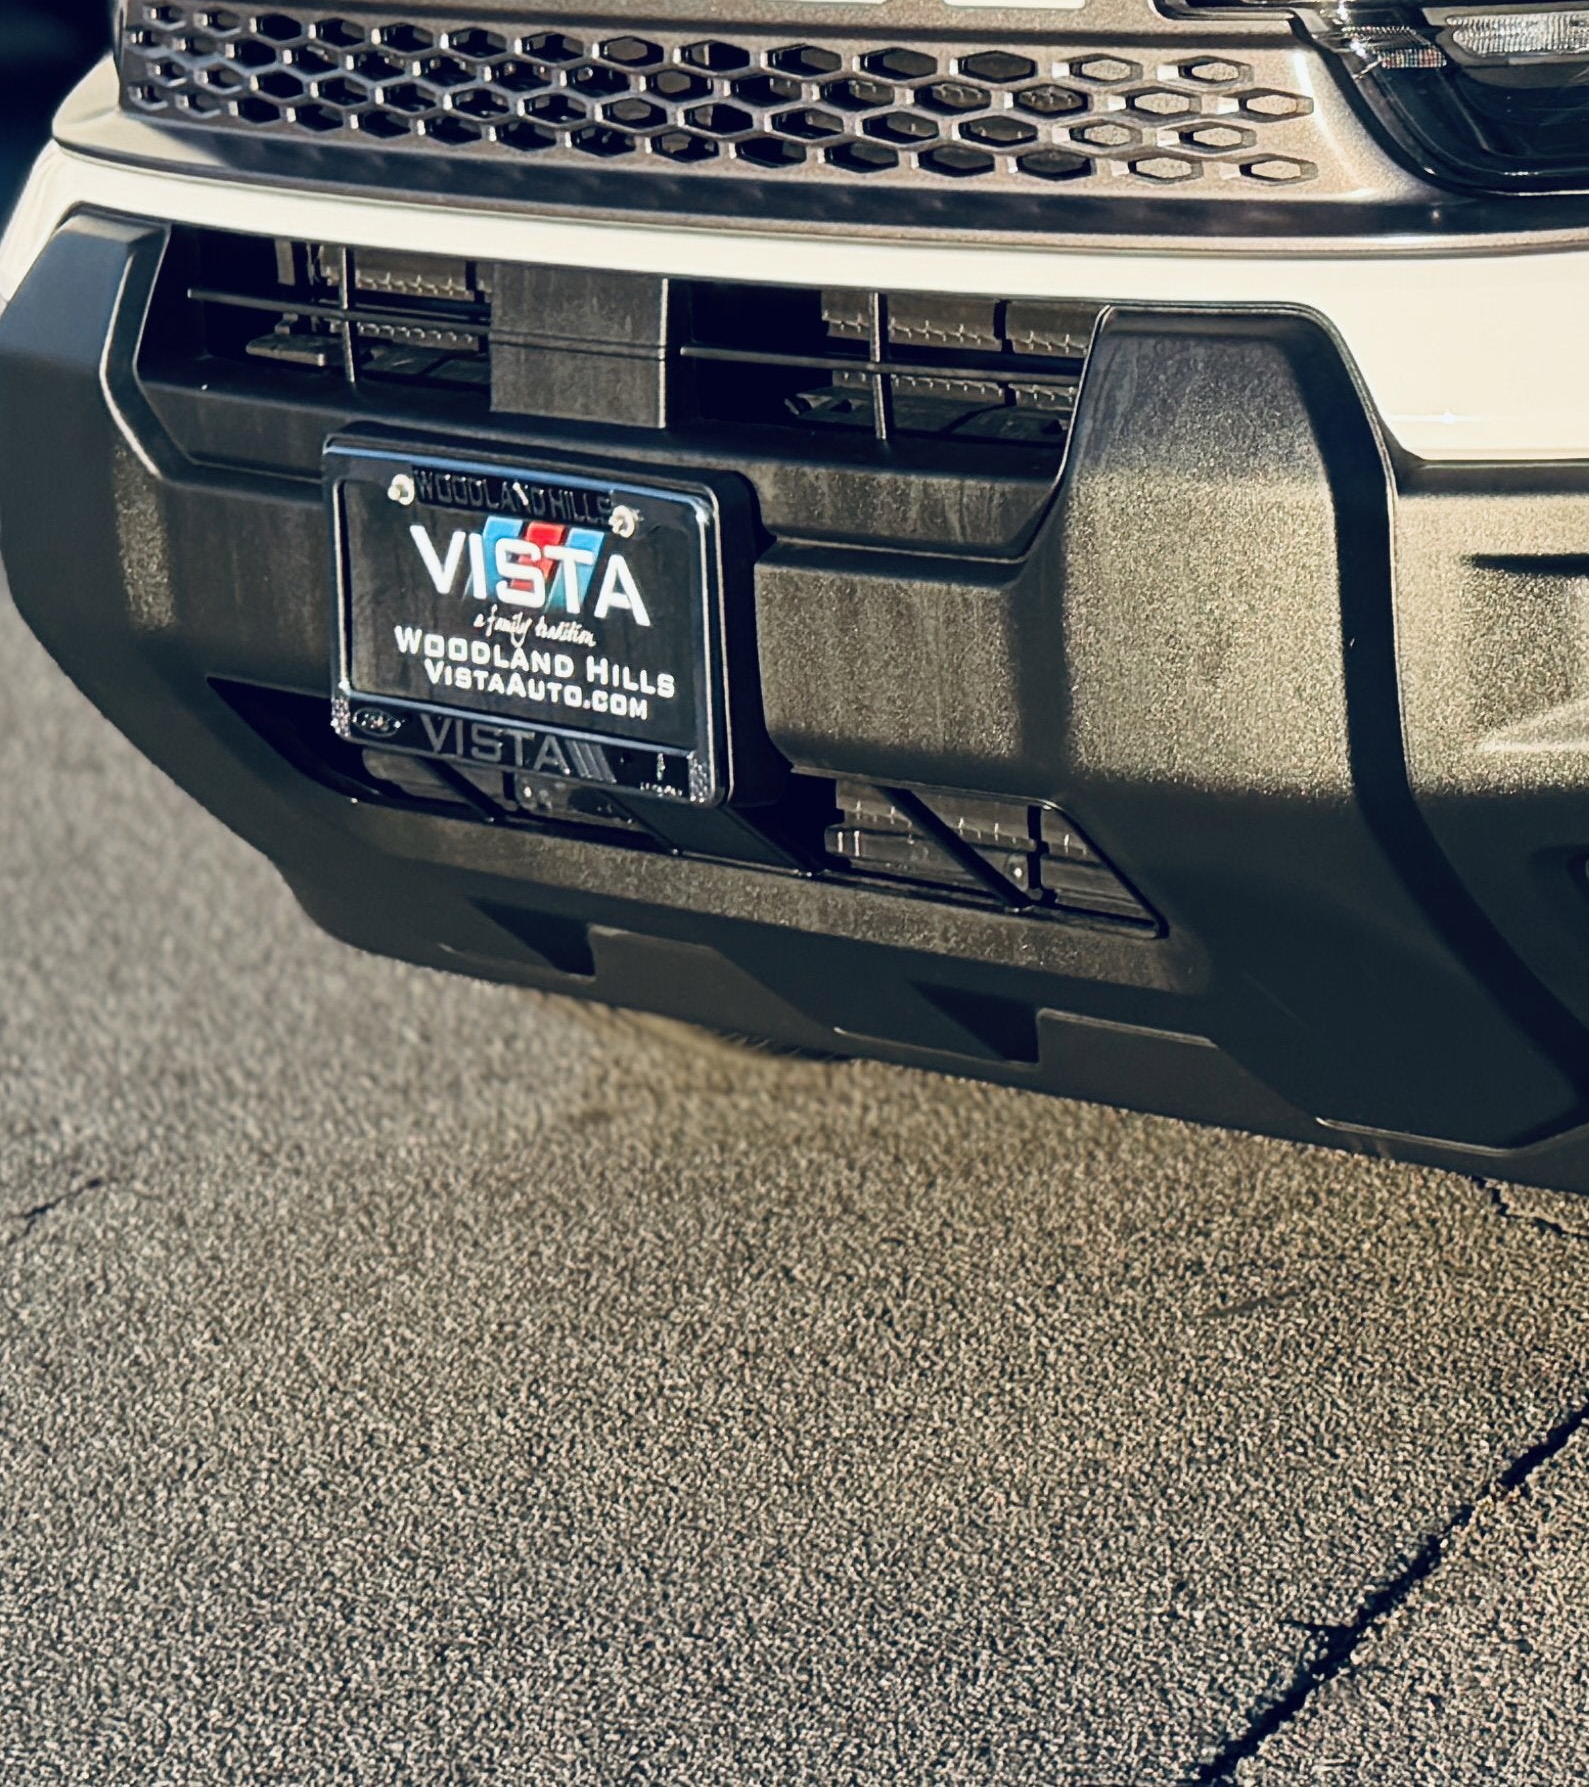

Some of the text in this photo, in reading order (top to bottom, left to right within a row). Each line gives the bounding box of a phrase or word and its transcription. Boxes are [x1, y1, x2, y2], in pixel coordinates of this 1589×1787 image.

[414, 469, 547, 517] WOODLAND
[409, 524, 652, 628] VISTA
[393, 625, 676, 699] WOODLAND HILLS
[420, 712, 571, 776] VISTA
